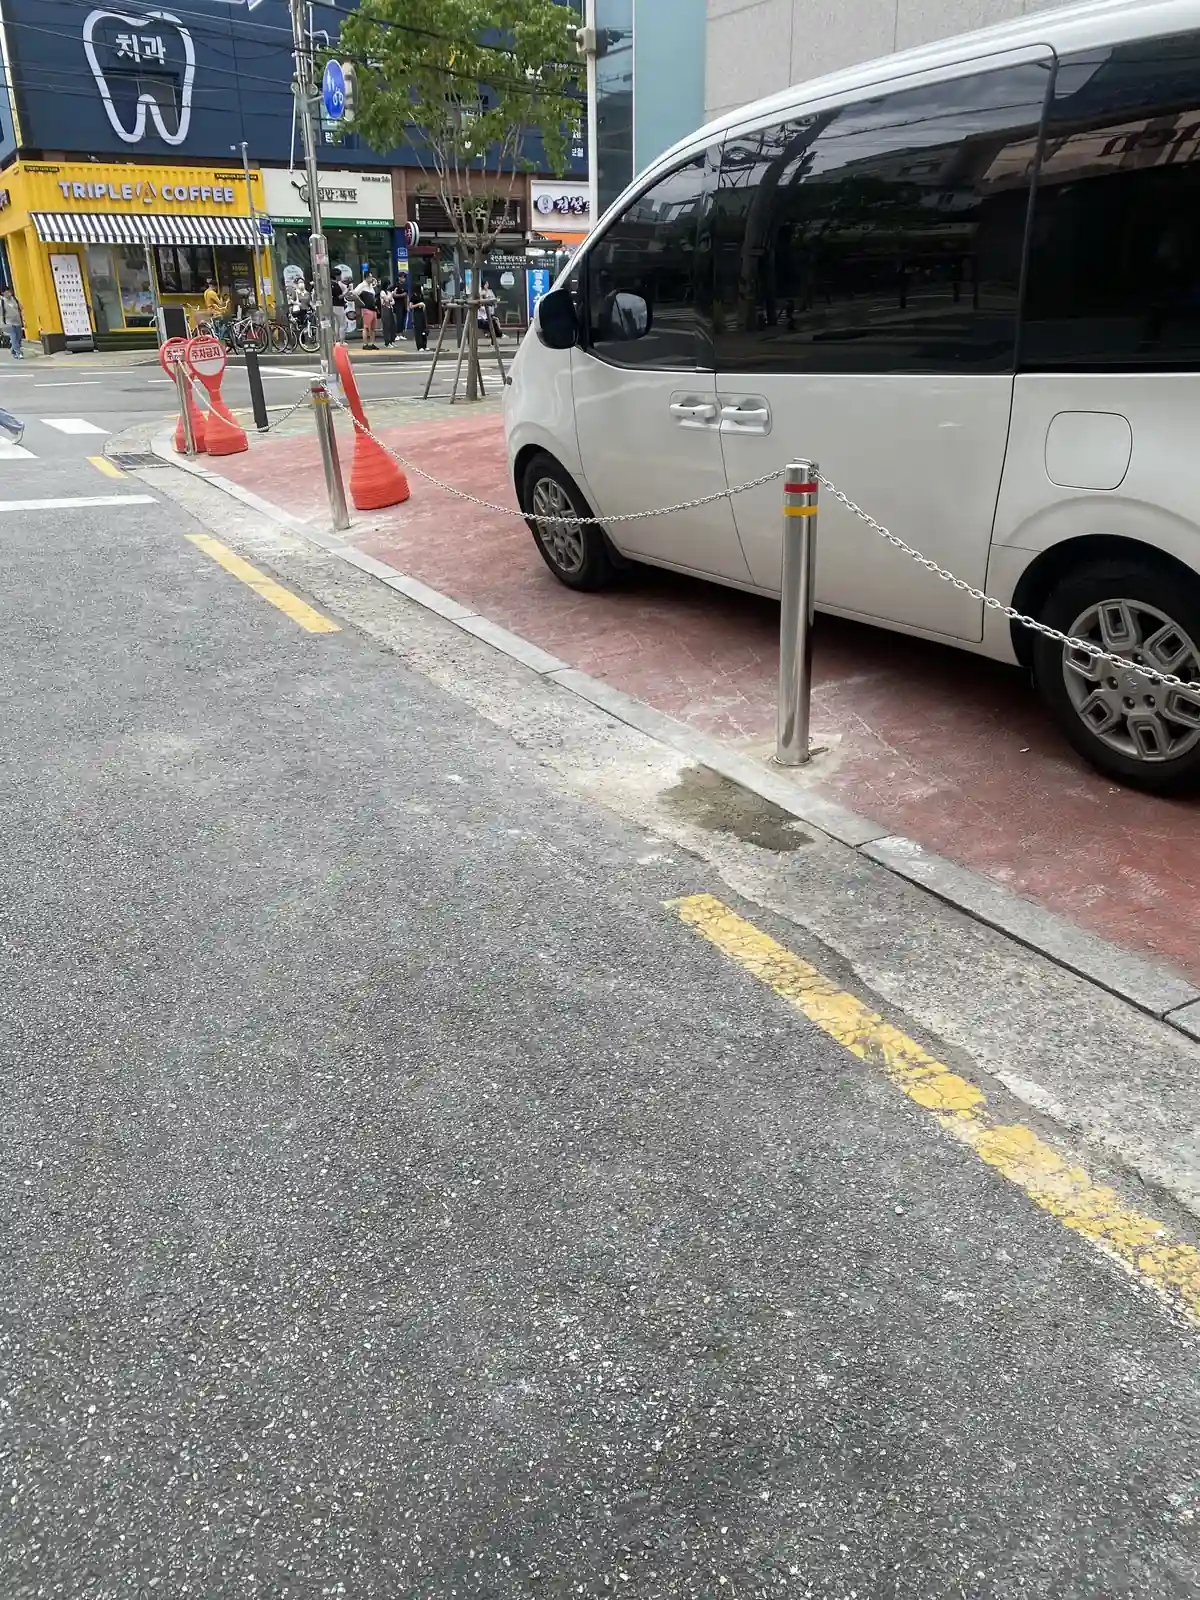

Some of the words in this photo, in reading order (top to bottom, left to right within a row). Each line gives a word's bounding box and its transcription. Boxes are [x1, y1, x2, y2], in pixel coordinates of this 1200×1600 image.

[115, 33, 167, 65] 치과
[58, 181, 134, 200] TRIPLE
[161, 183, 235, 204] COFFEE
[191, 346, 221, 360] 주차금지
